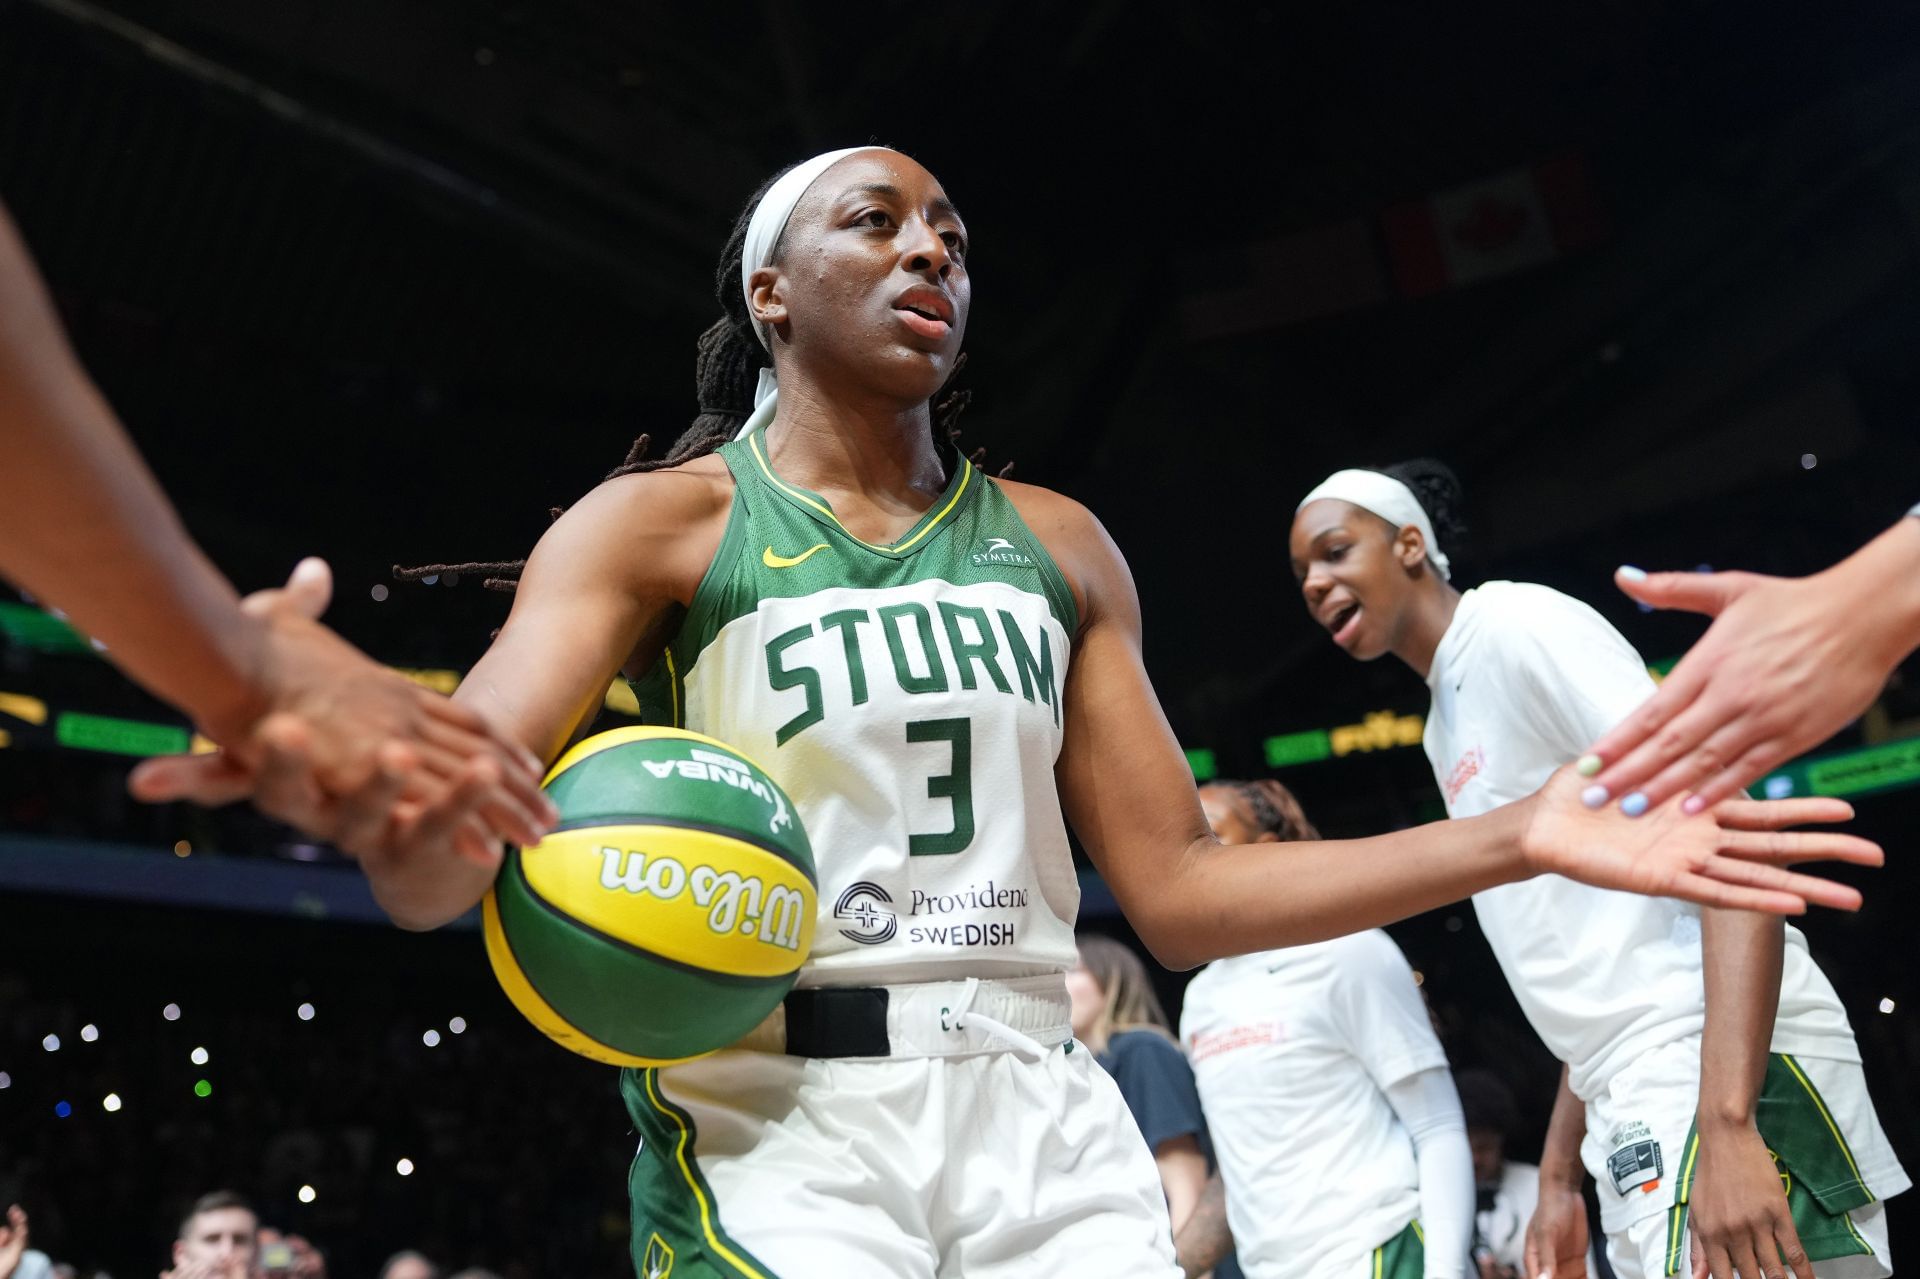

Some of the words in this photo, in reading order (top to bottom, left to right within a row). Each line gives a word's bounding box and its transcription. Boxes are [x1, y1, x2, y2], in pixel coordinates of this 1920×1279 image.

[972, 553, 1032, 564] SYMETRA
[765, 600, 1060, 748] STORM
[640, 759, 774, 804] WNBA
[906, 716, 976, 857] 3
[599, 845, 805, 951] Wilson
[908, 880, 1028, 916] Providenc
[910, 923, 1015, 947] SWEDISH
